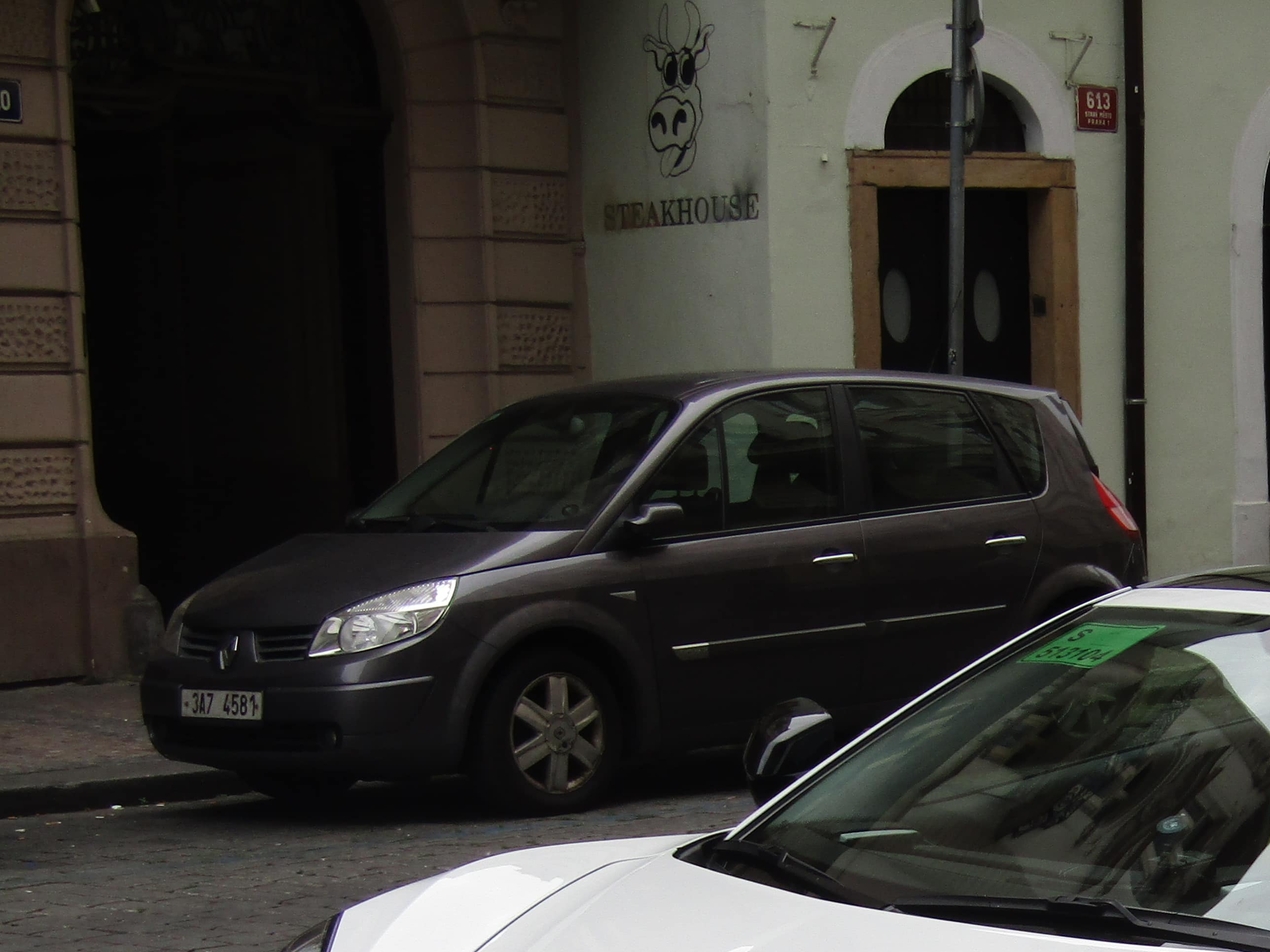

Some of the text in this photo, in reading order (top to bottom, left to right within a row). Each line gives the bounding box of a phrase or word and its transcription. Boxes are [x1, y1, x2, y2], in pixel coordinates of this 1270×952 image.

[1086, 91, 1110, 110] 613
[603, 193, 760, 232] STEAKHOUSE
[1036, 646, 1110, 662] 513104
[192, 692, 256, 717] 3A7 4581
